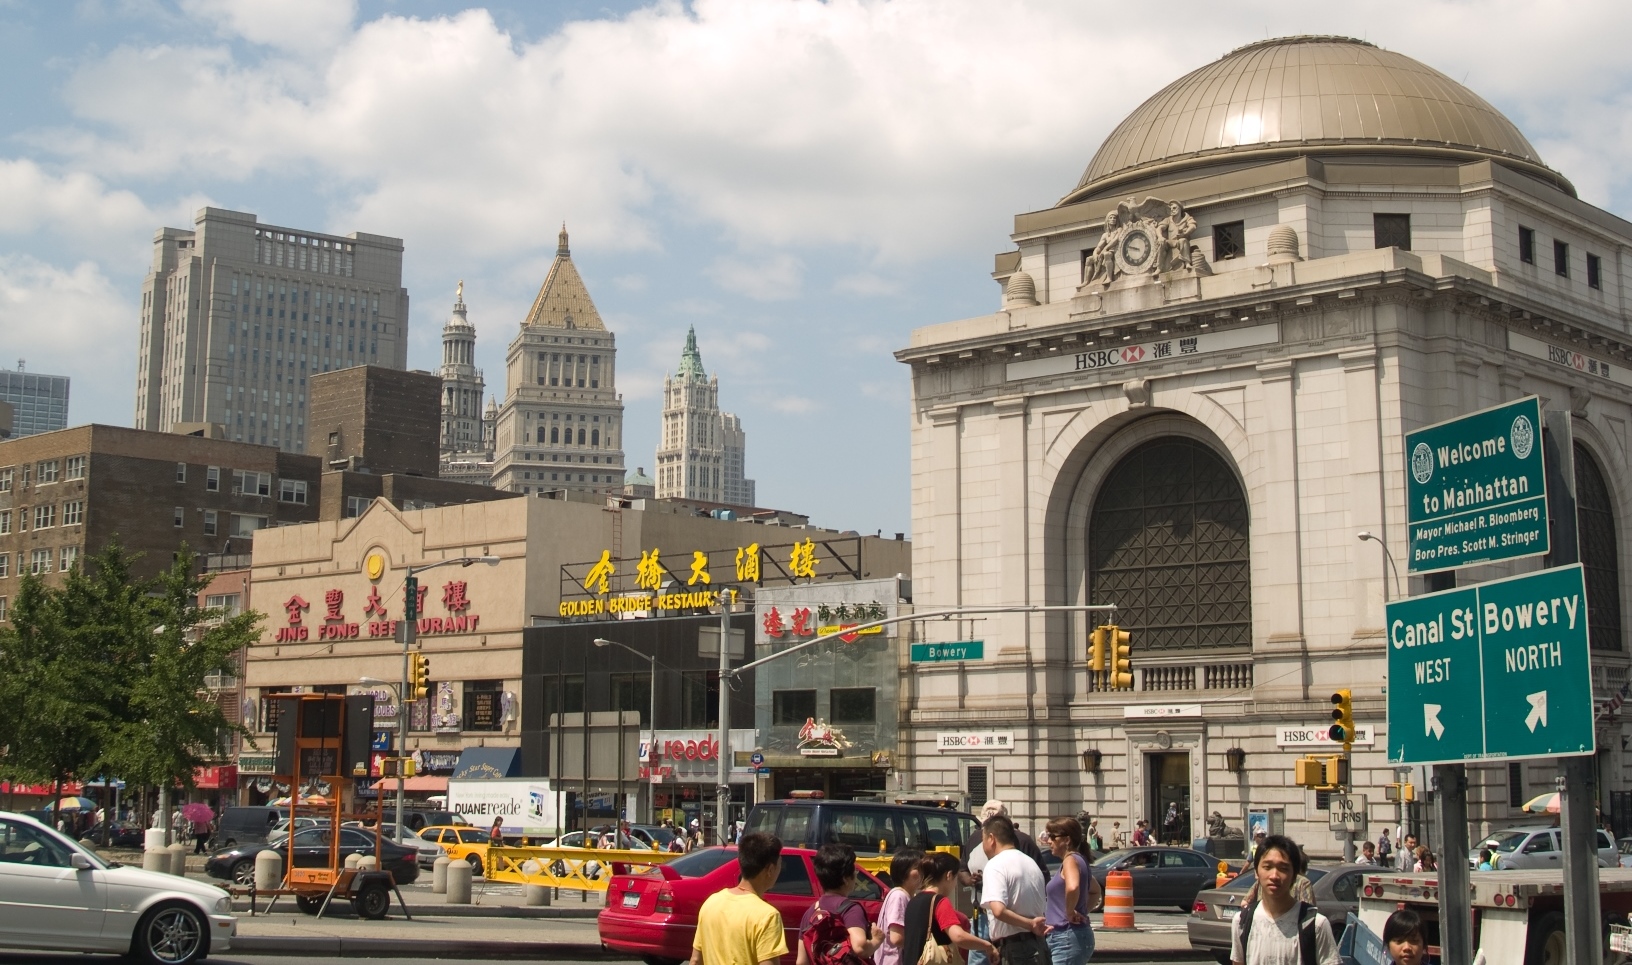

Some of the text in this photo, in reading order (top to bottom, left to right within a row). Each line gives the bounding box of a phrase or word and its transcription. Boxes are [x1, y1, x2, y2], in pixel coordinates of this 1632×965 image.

[1075, 349, 1121, 370] HSBC
[1548, 345, 1572, 366] HSBC
[1437, 435, 1505, 468] Welcome
[1423, 475, 1528, 514] to Manhattan
[1417, 506, 1538, 542] Mayor Michael R. Bloomberg
[1415, 530, 1539, 561] Boro Pres. Scott M. Stringer
[584, 537, 820, 595] 金橋大酒樓
[560, 590, 737, 616] GOLDEN BRIDGE RESTAURT
[1484, 594, 1578, 634] Bowery
[275, 615, 479, 642] JING FONG RESAURANT
[1392, 607, 1474, 649] Canal St
[929, 647, 967, 658] Bowery
[1505, 641, 1562, 673] NORTH
[1415, 658, 1451, 685] WEST
[943, 736, 966, 745] HSBC
[1284, 731, 1313, 741] HSBC
[455, 798, 521, 815] DUANE reade
[1332, 812, 1361, 823] TURNS
[1339, 800, 1353, 810] NO
